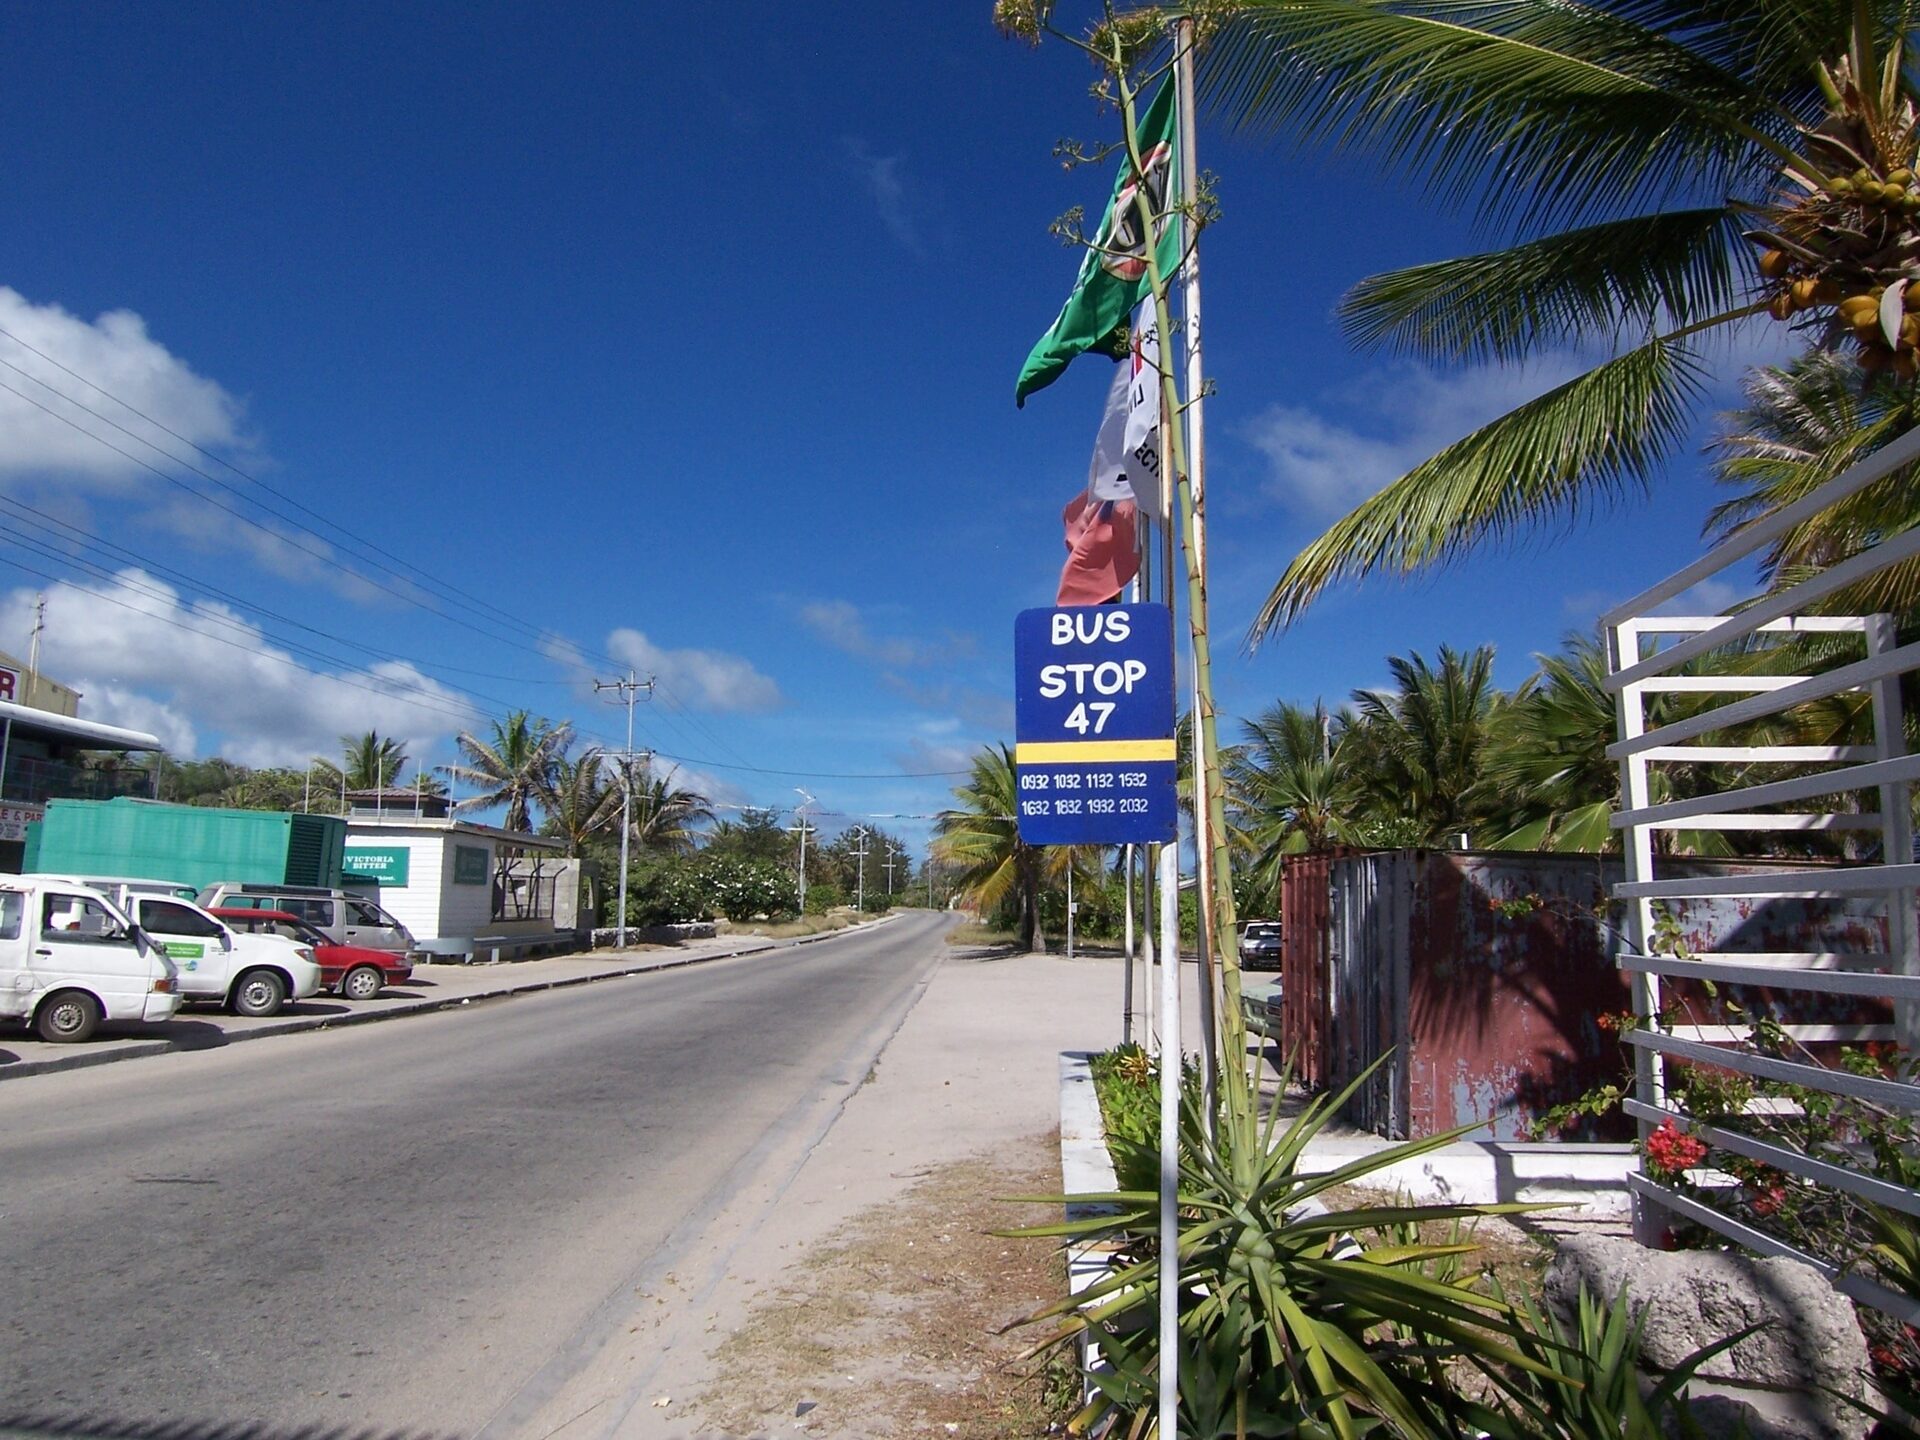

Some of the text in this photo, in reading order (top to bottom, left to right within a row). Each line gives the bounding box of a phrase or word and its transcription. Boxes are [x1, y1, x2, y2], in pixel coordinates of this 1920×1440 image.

[1051, 610, 1131, 645] BUS
[1039, 659, 1147, 698] STOP
[1063, 702, 1116, 735] 47
[1021, 772, 1147, 790] 0932 1032 1132 1532
[1021, 798, 1148, 816] 1632 1832 1932 2032
[346, 855, 395, 863] VICTORIA
[352, 862, 387, 870] BITTER
